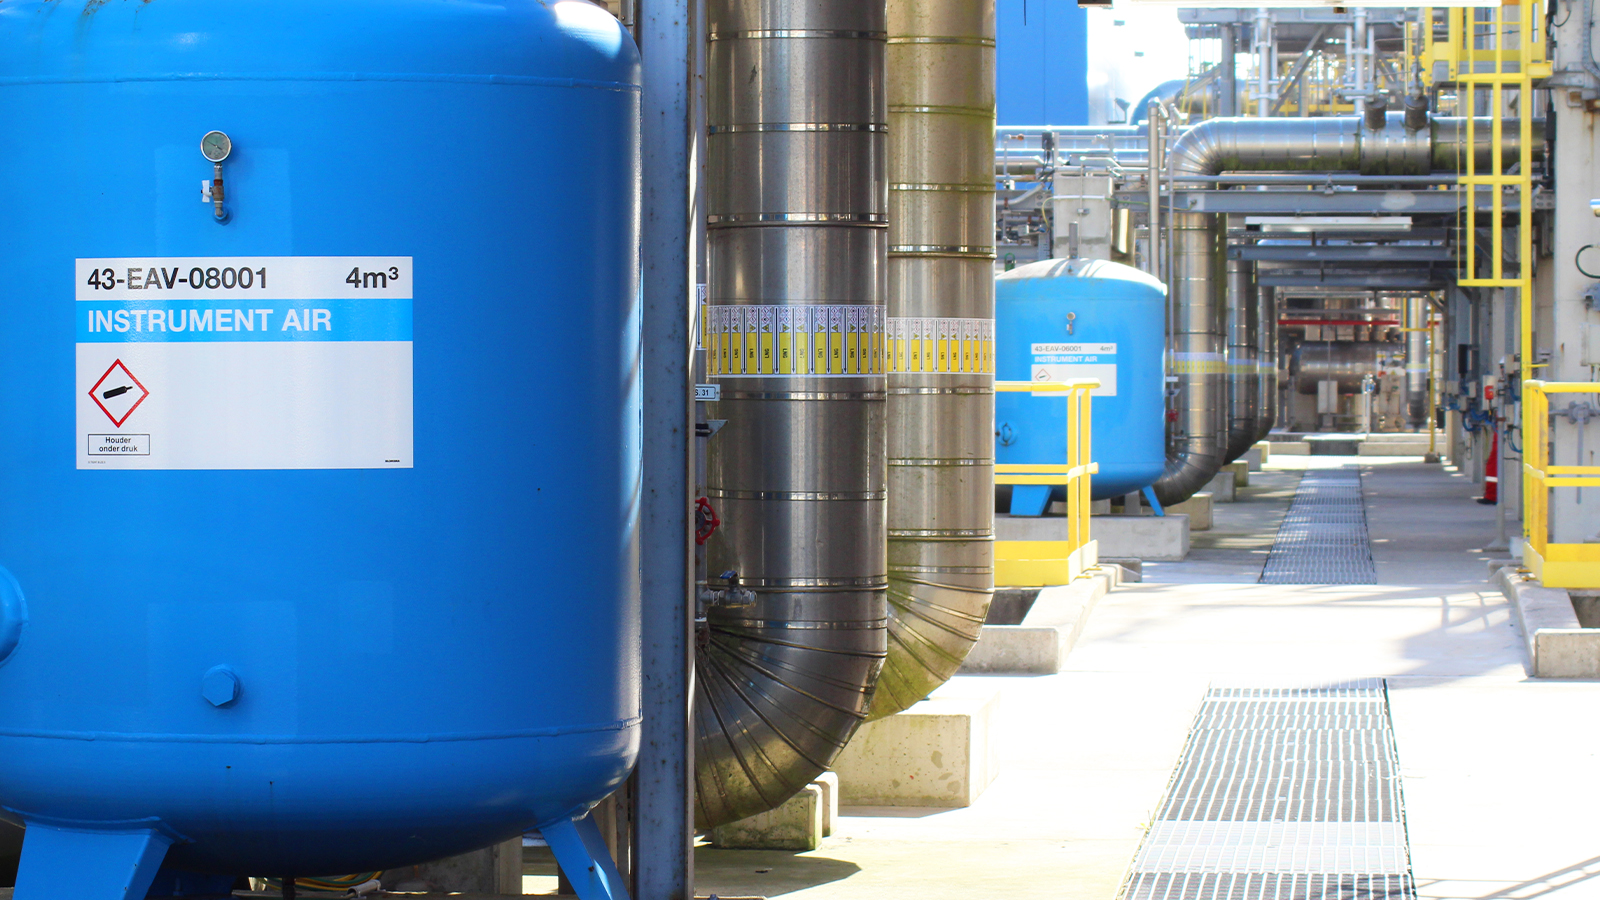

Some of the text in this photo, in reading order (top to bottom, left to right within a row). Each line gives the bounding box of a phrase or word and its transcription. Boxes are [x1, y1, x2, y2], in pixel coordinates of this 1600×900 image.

[87, 267, 267, 290] 43-EAV-08001
[88, 309, 332, 333] INSTRUMENT AIR
